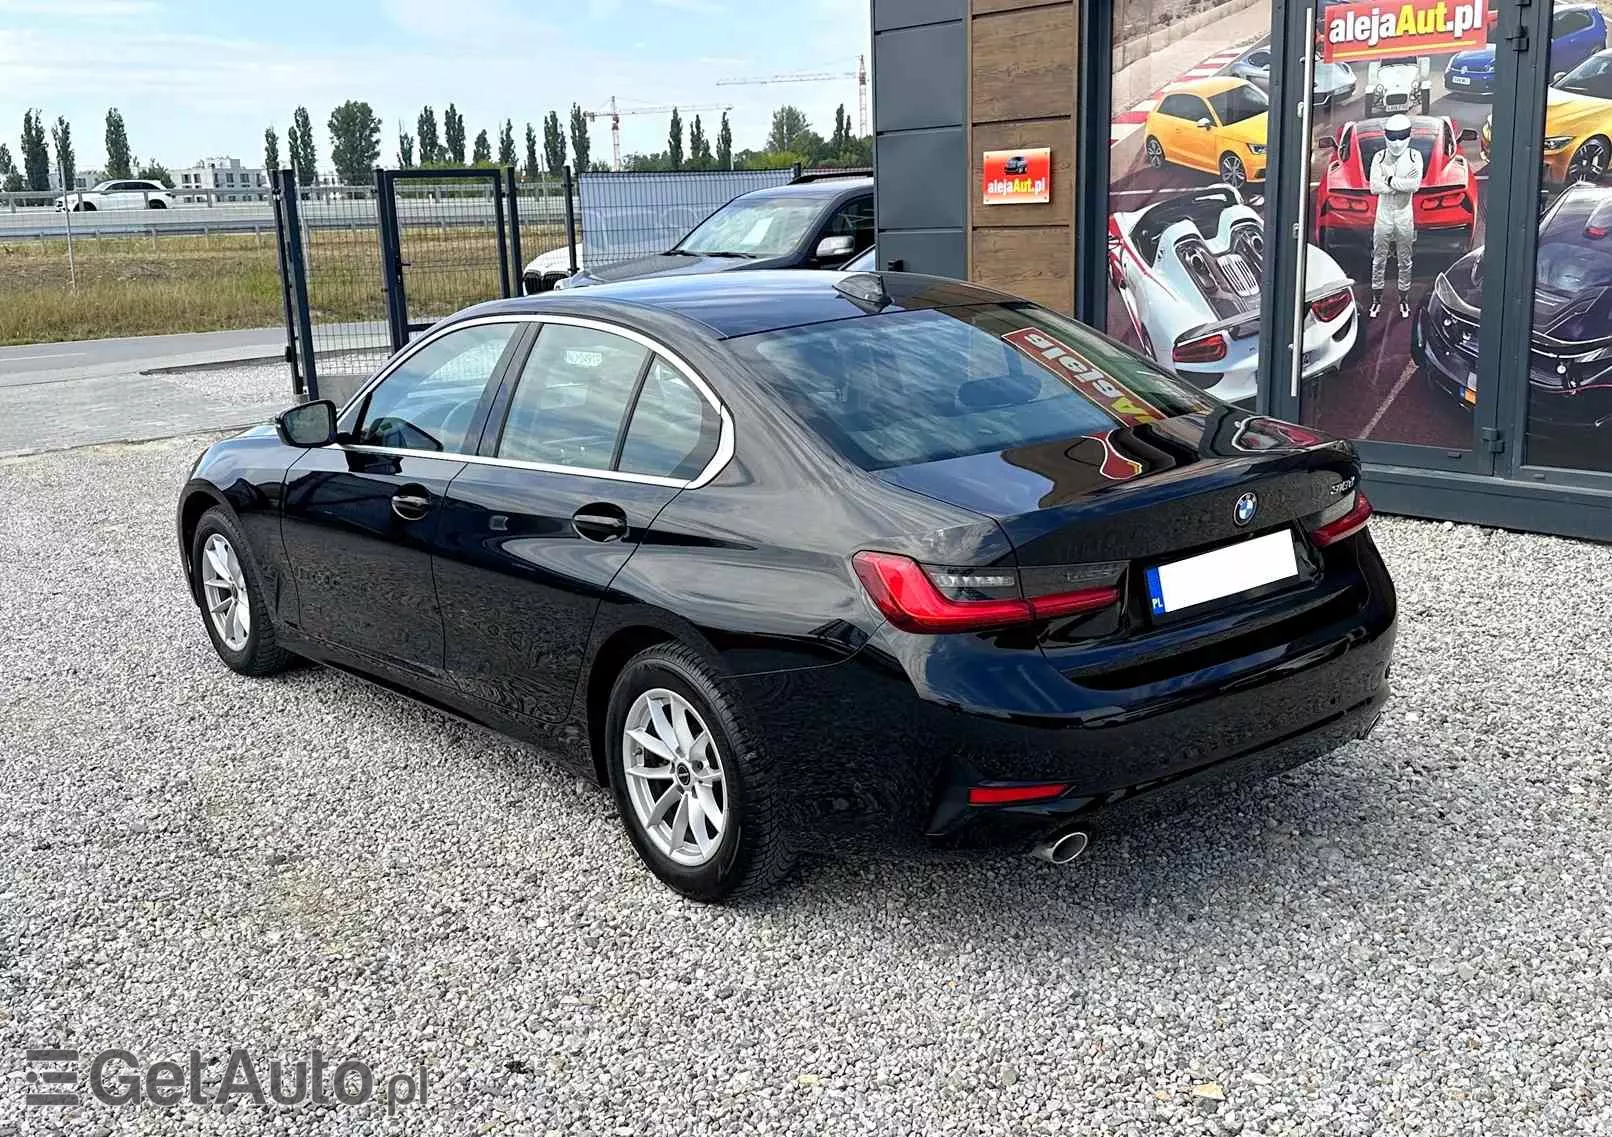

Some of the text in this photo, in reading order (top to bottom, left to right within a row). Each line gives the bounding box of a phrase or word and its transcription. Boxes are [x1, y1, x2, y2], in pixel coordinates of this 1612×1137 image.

[1329, 0, 1483, 46] alejaAut.pl
[987, 177, 1046, 196] alejaAut.pl
[1152, 597, 1164, 608] PL
